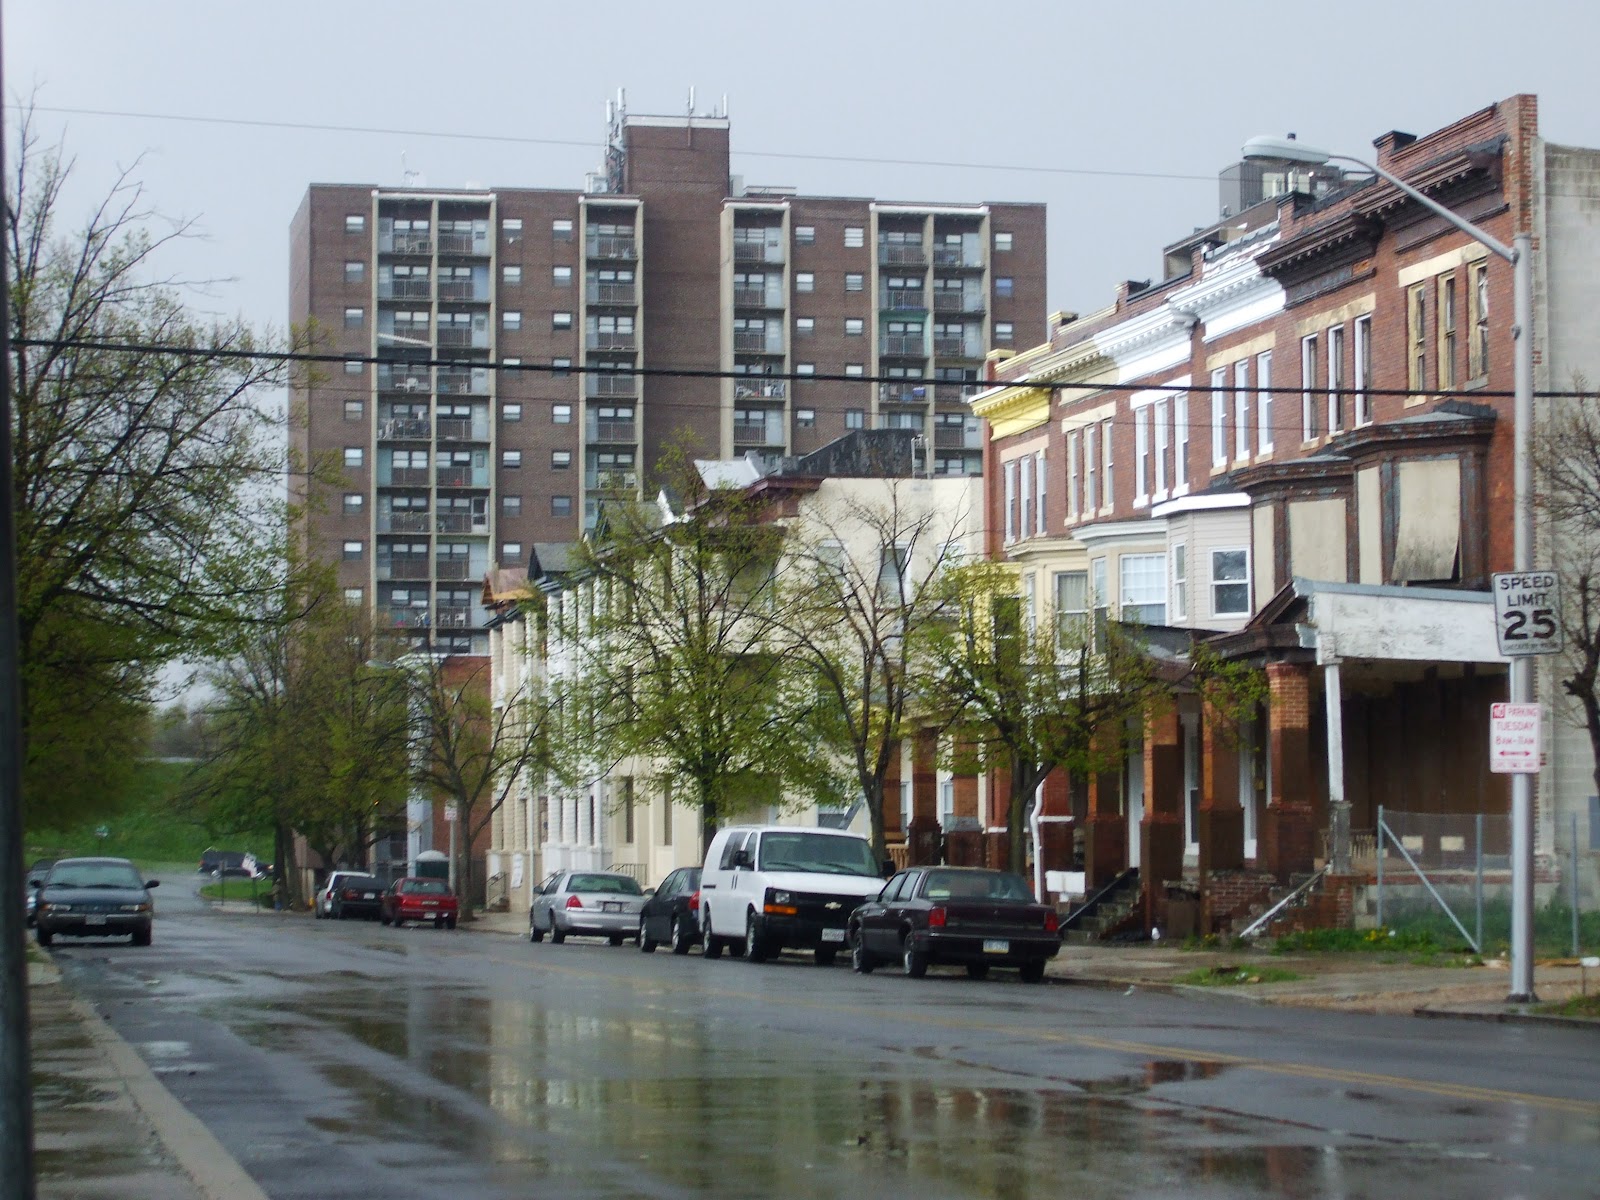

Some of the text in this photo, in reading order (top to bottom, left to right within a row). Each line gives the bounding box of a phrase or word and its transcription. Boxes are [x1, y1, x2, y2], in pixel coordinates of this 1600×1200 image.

[1500, 576, 1554, 590] SPEED
[1507, 593, 1548, 607] LIMIT
[1503, 609, 1556, 640] 25
[1497, 721, 1535, 731] TUESDAY
